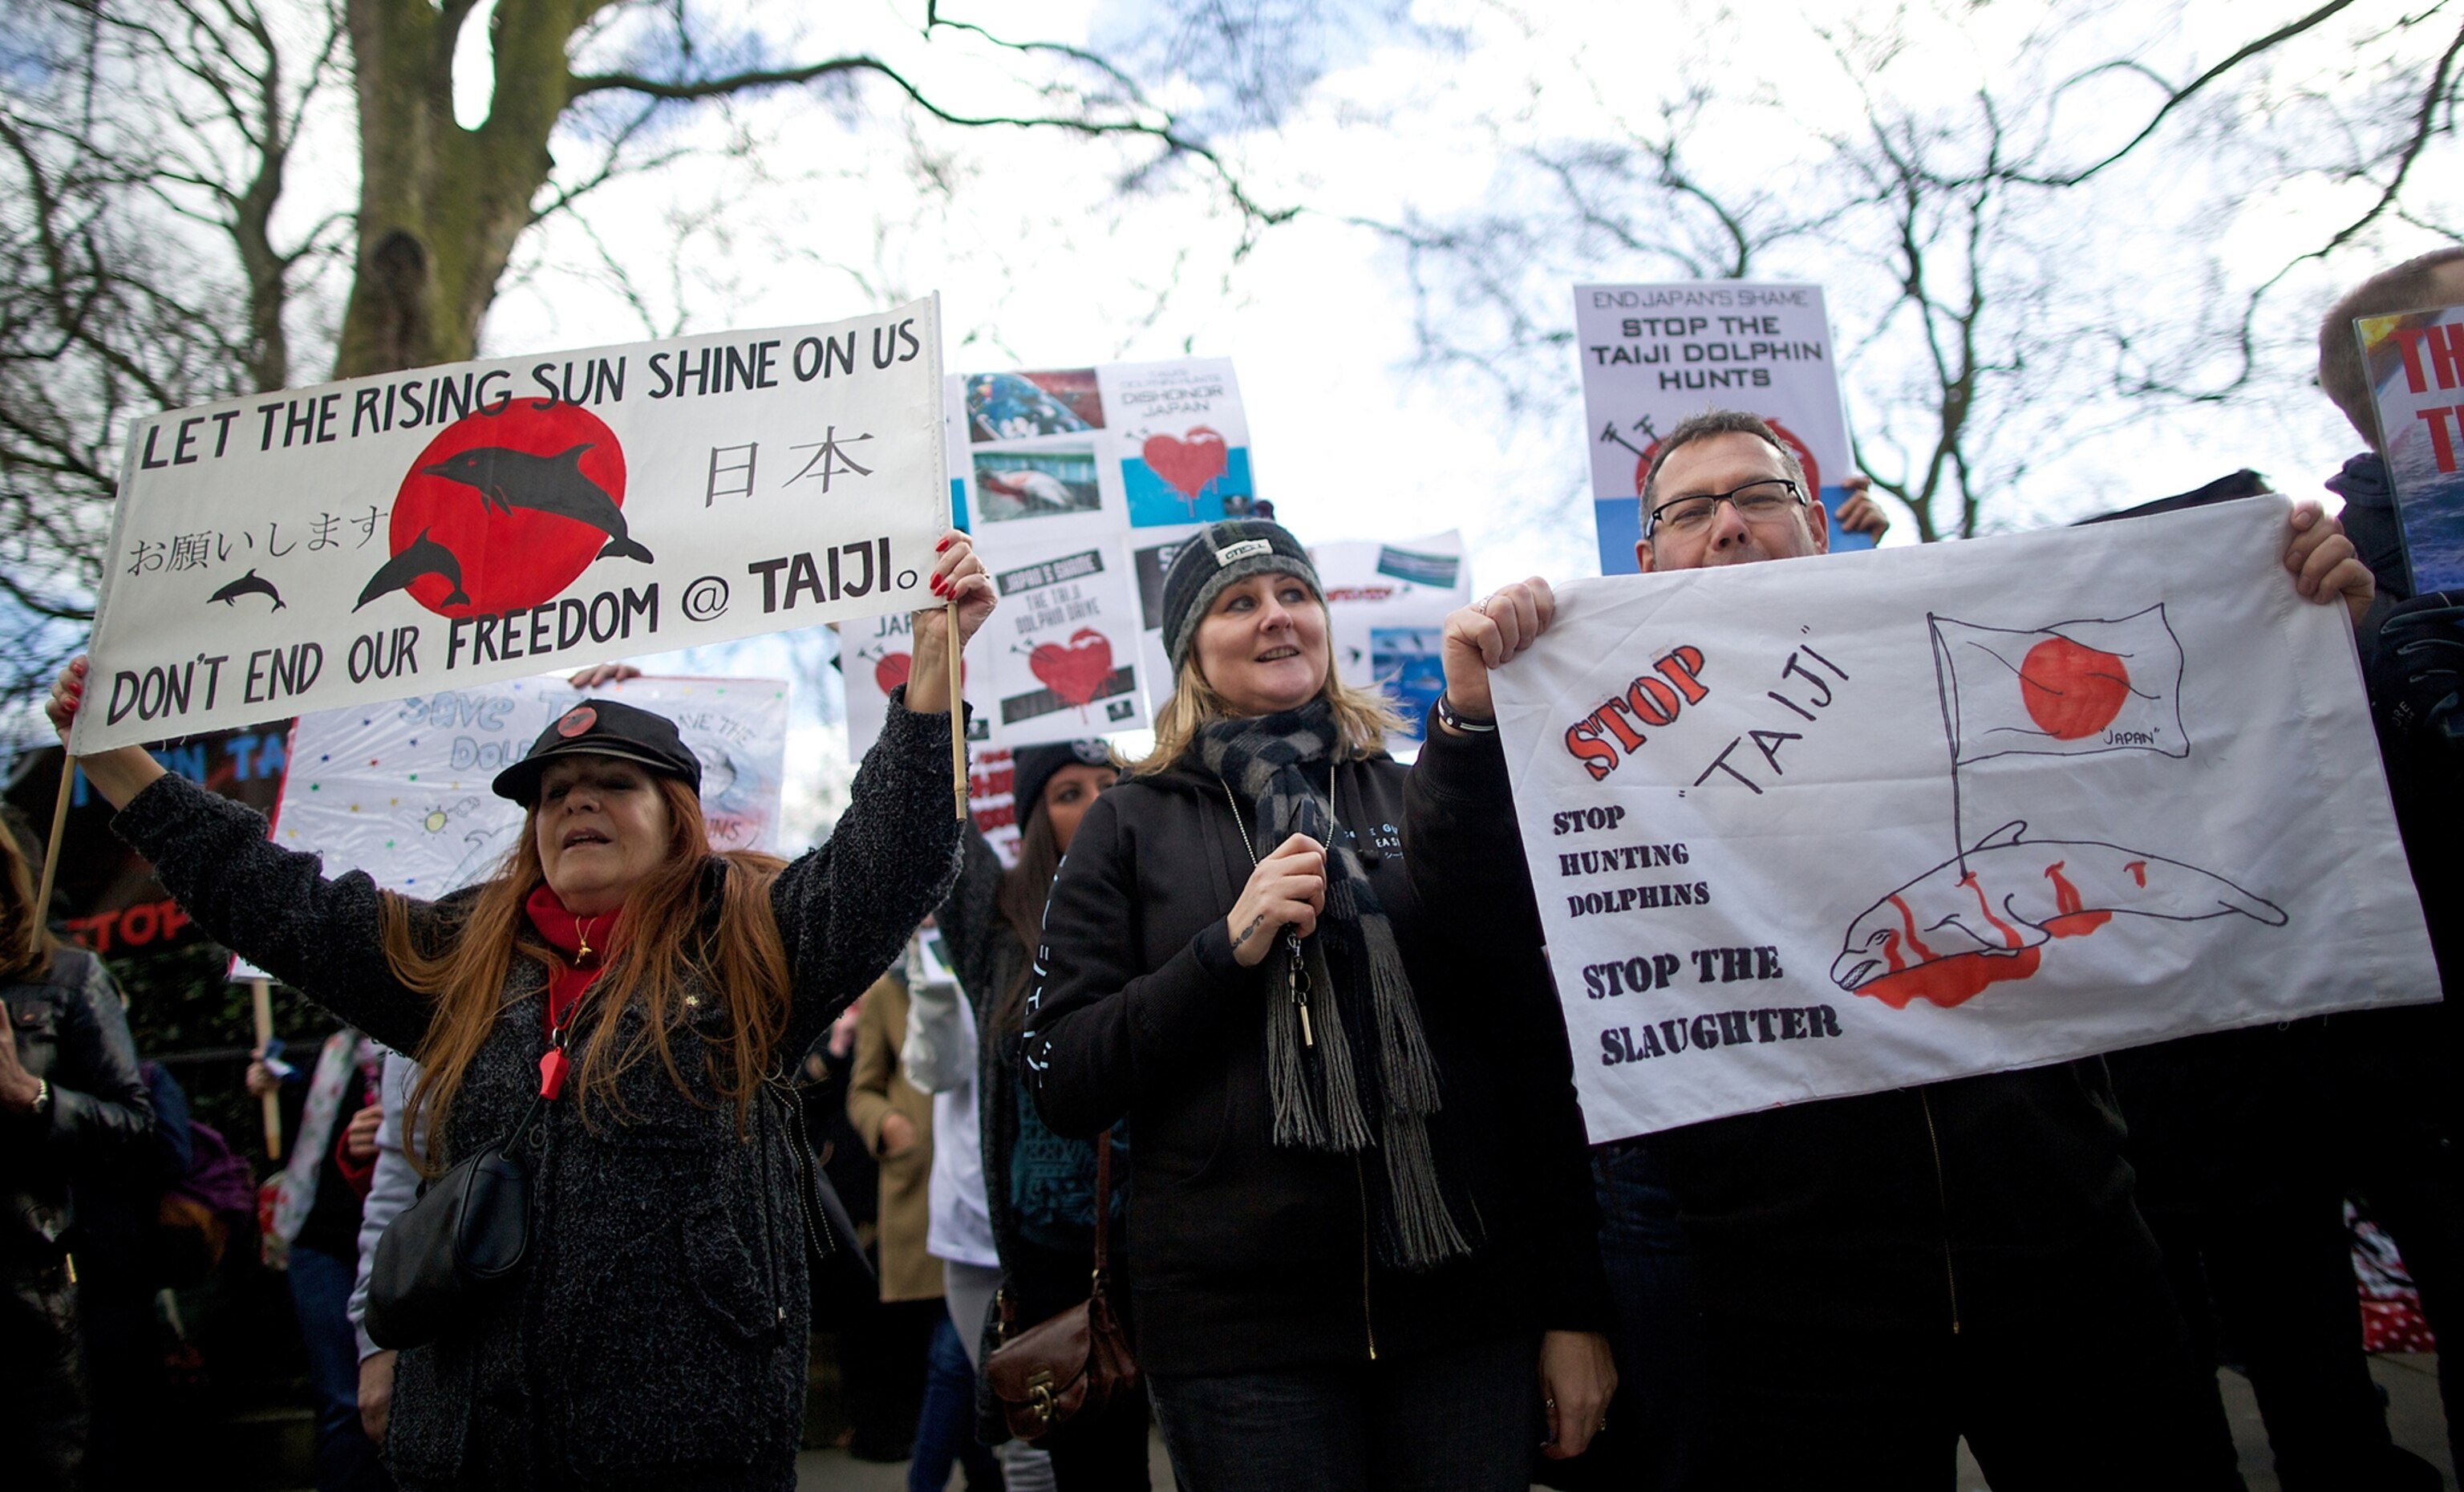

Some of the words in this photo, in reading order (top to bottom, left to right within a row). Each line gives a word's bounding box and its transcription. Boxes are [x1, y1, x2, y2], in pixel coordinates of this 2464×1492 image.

[1594, 291, 1639, 309] END
[1738, 290, 1808, 308] SHAME
[1622, 317, 1708, 337] STOP
[1719, 316, 1781, 335] THE
[1590, 344, 1670, 365] TAIJI
[1683, 342, 1823, 363] DOLPHIN
[141, 410, 240, 470] LET
[257, 393, 342, 452] THE
[351, 369, 513, 438] RISING
[531, 355, 626, 411] SUN
[648, 339, 781, 399] SHINE
[793, 330, 856, 383] ON
[872, 318, 920, 370] US
[1121, 385, 1225, 404] DISHONOR
[1659, 368, 1772, 390] HUNTS
[1141, 401, 1210, 418] JAPAN
[705, 425, 875, 509] 日本
[126, 505, 390, 577] お願いします
[107, 652, 229, 727] DON'T
[243, 641, 324, 704] END
[347, 624, 420, 684] OUR
[445, 582, 660, 670] FREEDOM
[680, 574, 731, 622] @
[1565, 645, 1710, 782] STOP
[1553, 805, 1626, 836] STOP
[1558, 843, 1689, 877] HUNTING
[1567, 882, 1711, 918] DOLPHINS
[1583, 953, 1681, 1000] STOP
[1691, 945, 1783, 983] THE
[1600, 1003, 1843, 1066] SLAUGHTER
